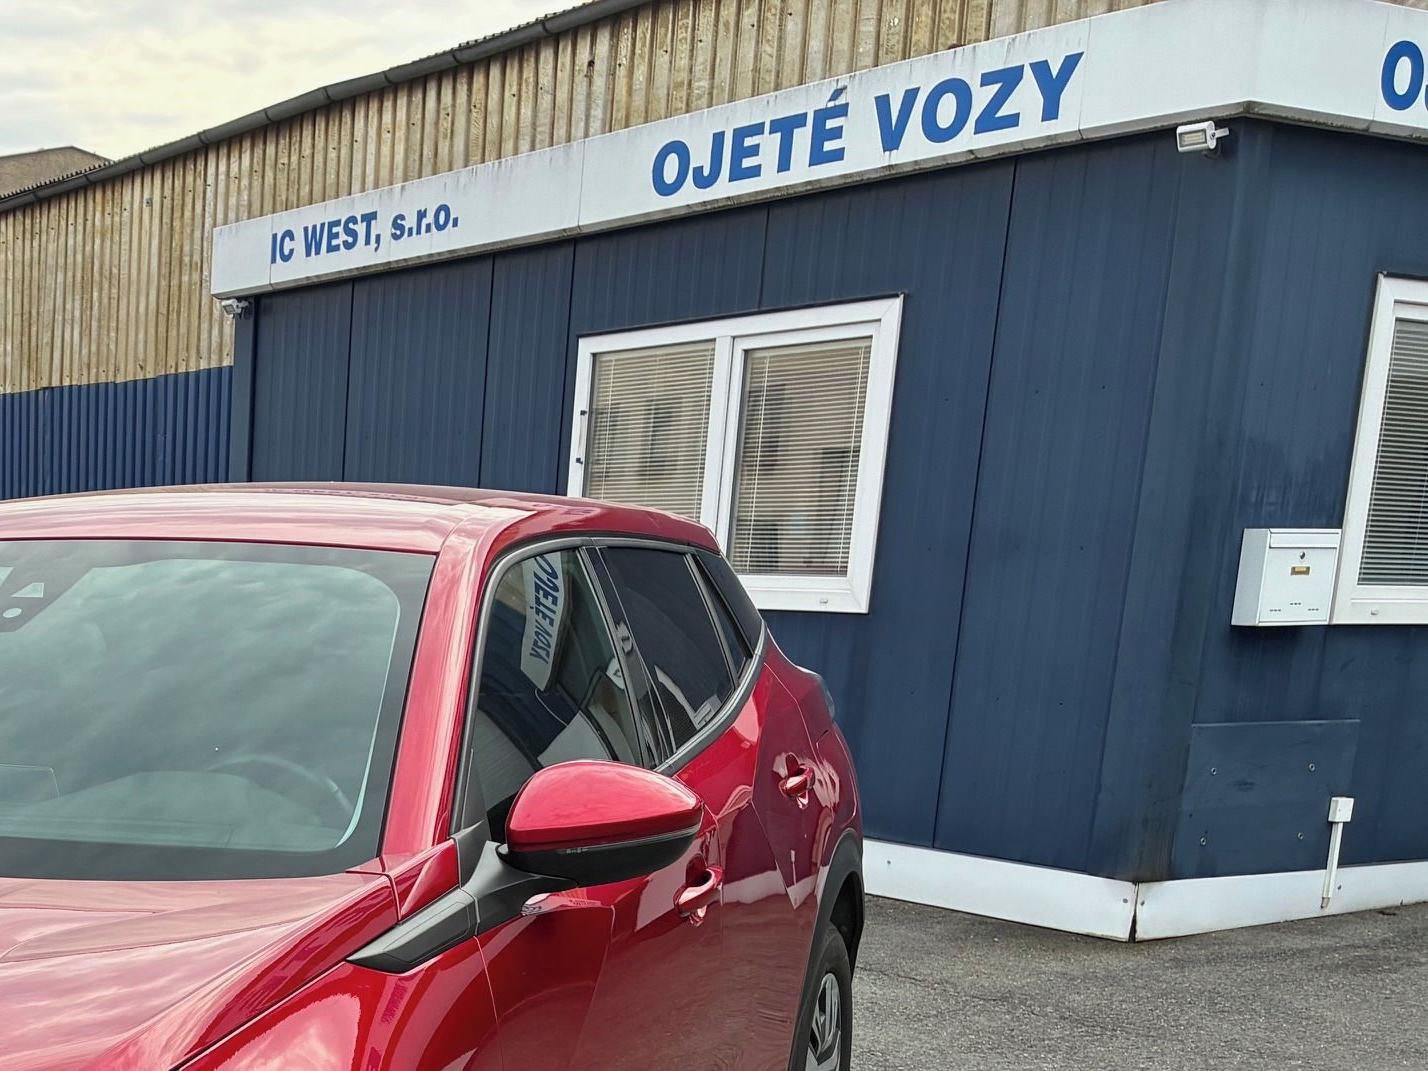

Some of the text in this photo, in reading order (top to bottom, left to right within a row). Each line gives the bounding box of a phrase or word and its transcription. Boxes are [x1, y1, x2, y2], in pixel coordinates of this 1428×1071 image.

[1380, 40, 1428, 111] O
[652, 51, 1084, 197] OJETÉ VOZY
[271, 203, 459, 265] IC WEST, s.r.o.
